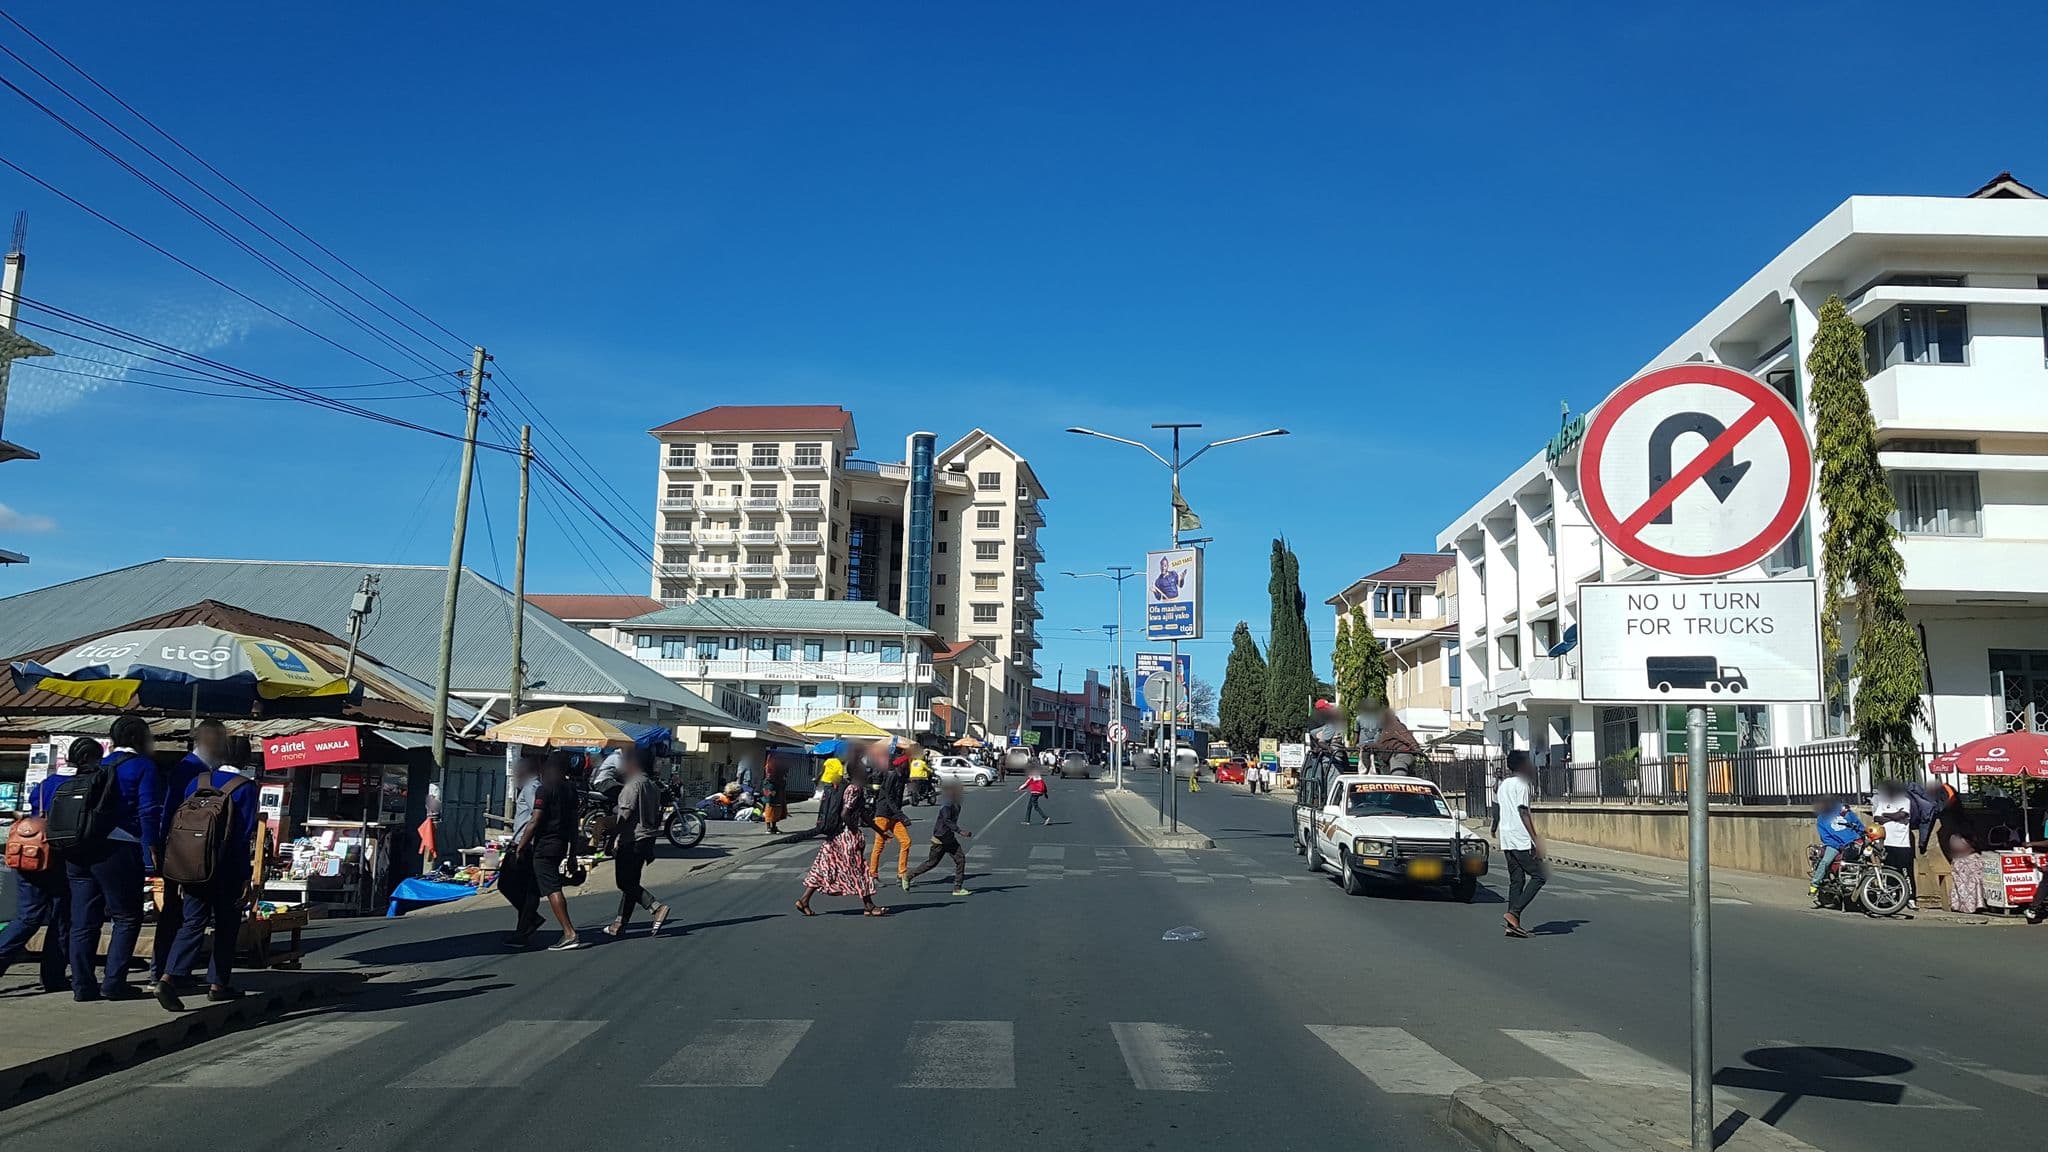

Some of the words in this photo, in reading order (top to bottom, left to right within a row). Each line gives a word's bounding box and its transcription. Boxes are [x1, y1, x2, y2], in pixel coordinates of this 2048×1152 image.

[1628, 593, 1659, 610] NO
[1672, 593, 1686, 610] U
[1699, 592, 1760, 610] TURN
[1161, 604, 1187, 613] maalum
[1149, 613, 1162, 621] kwa
[1174, 611, 1190, 621] yako
[1627, 618, 1671, 635] FOR
[1683, 616, 1775, 635] TRUCKS
[76, 643, 140, 664] tigo
[161, 646, 231, 669] tigo
[280, 741, 306, 753] airtel
[314, 740, 350, 751] WAKALA
[281, 752, 307, 761] money
[1975, 765, 2004, 773] M-Pawa
[1355, 783, 1383, 793] ZERO
[1383, 783, 1432, 794] DISTANCE
[2004, 875, 2033, 883] Wakala
